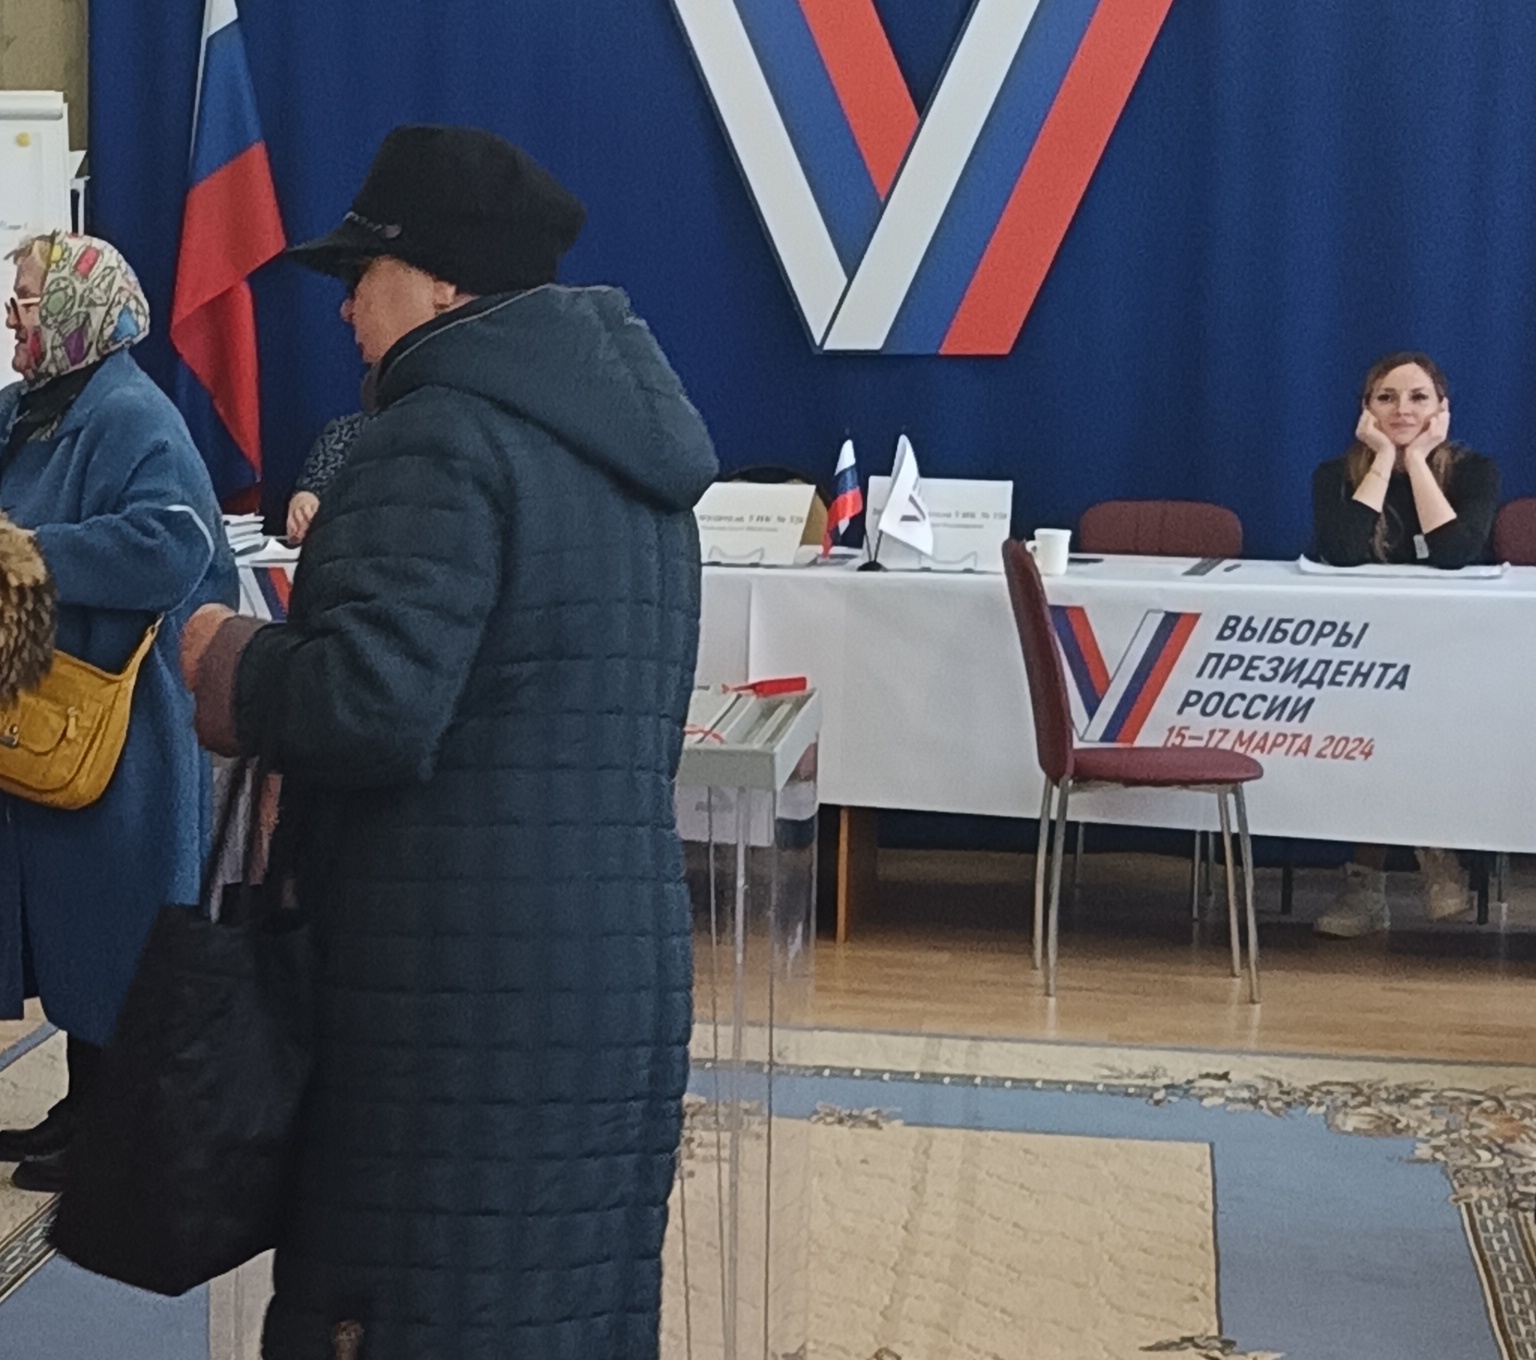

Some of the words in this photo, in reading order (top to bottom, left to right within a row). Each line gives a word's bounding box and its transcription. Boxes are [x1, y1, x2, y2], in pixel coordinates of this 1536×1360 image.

[1215, 614, 1370, 649] ВЫБОРЫ
[1195, 652, 1412, 691] ПРЕЗИДЕНТА
[1176, 689, 1315, 724] РОССИИ
[1231, 729, 1314, 758] МАРТА
[1315, 735, 1376, 761] 2024
